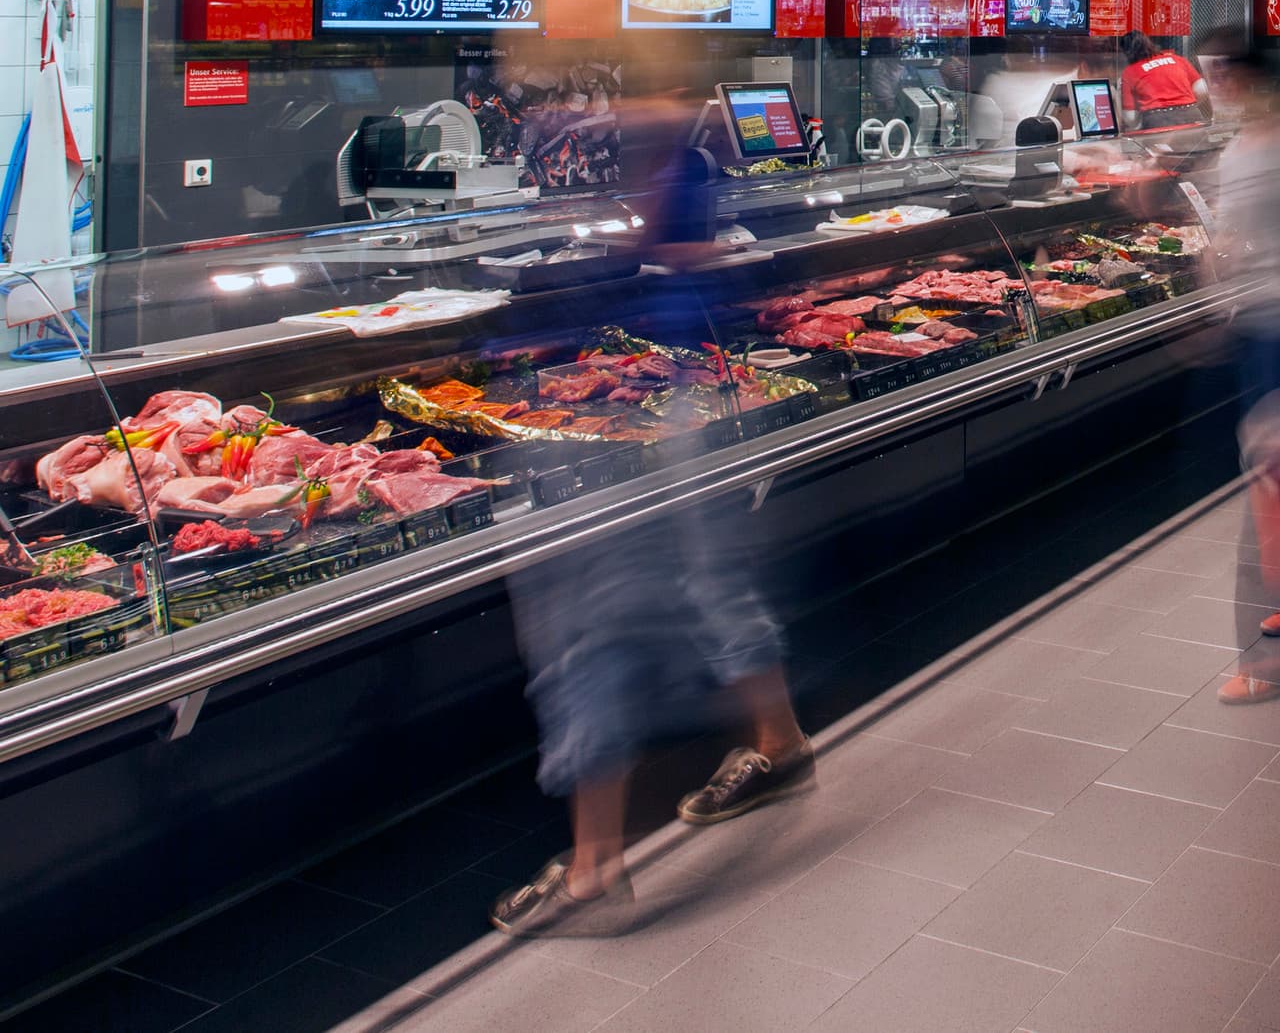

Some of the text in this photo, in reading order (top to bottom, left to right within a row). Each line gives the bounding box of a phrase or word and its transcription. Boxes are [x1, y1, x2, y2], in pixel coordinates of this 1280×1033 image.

[497, 0, 532, 19] 2.79
[459, 49, 482, 57] Besser
[1141, 57, 1177, 72] REWE
